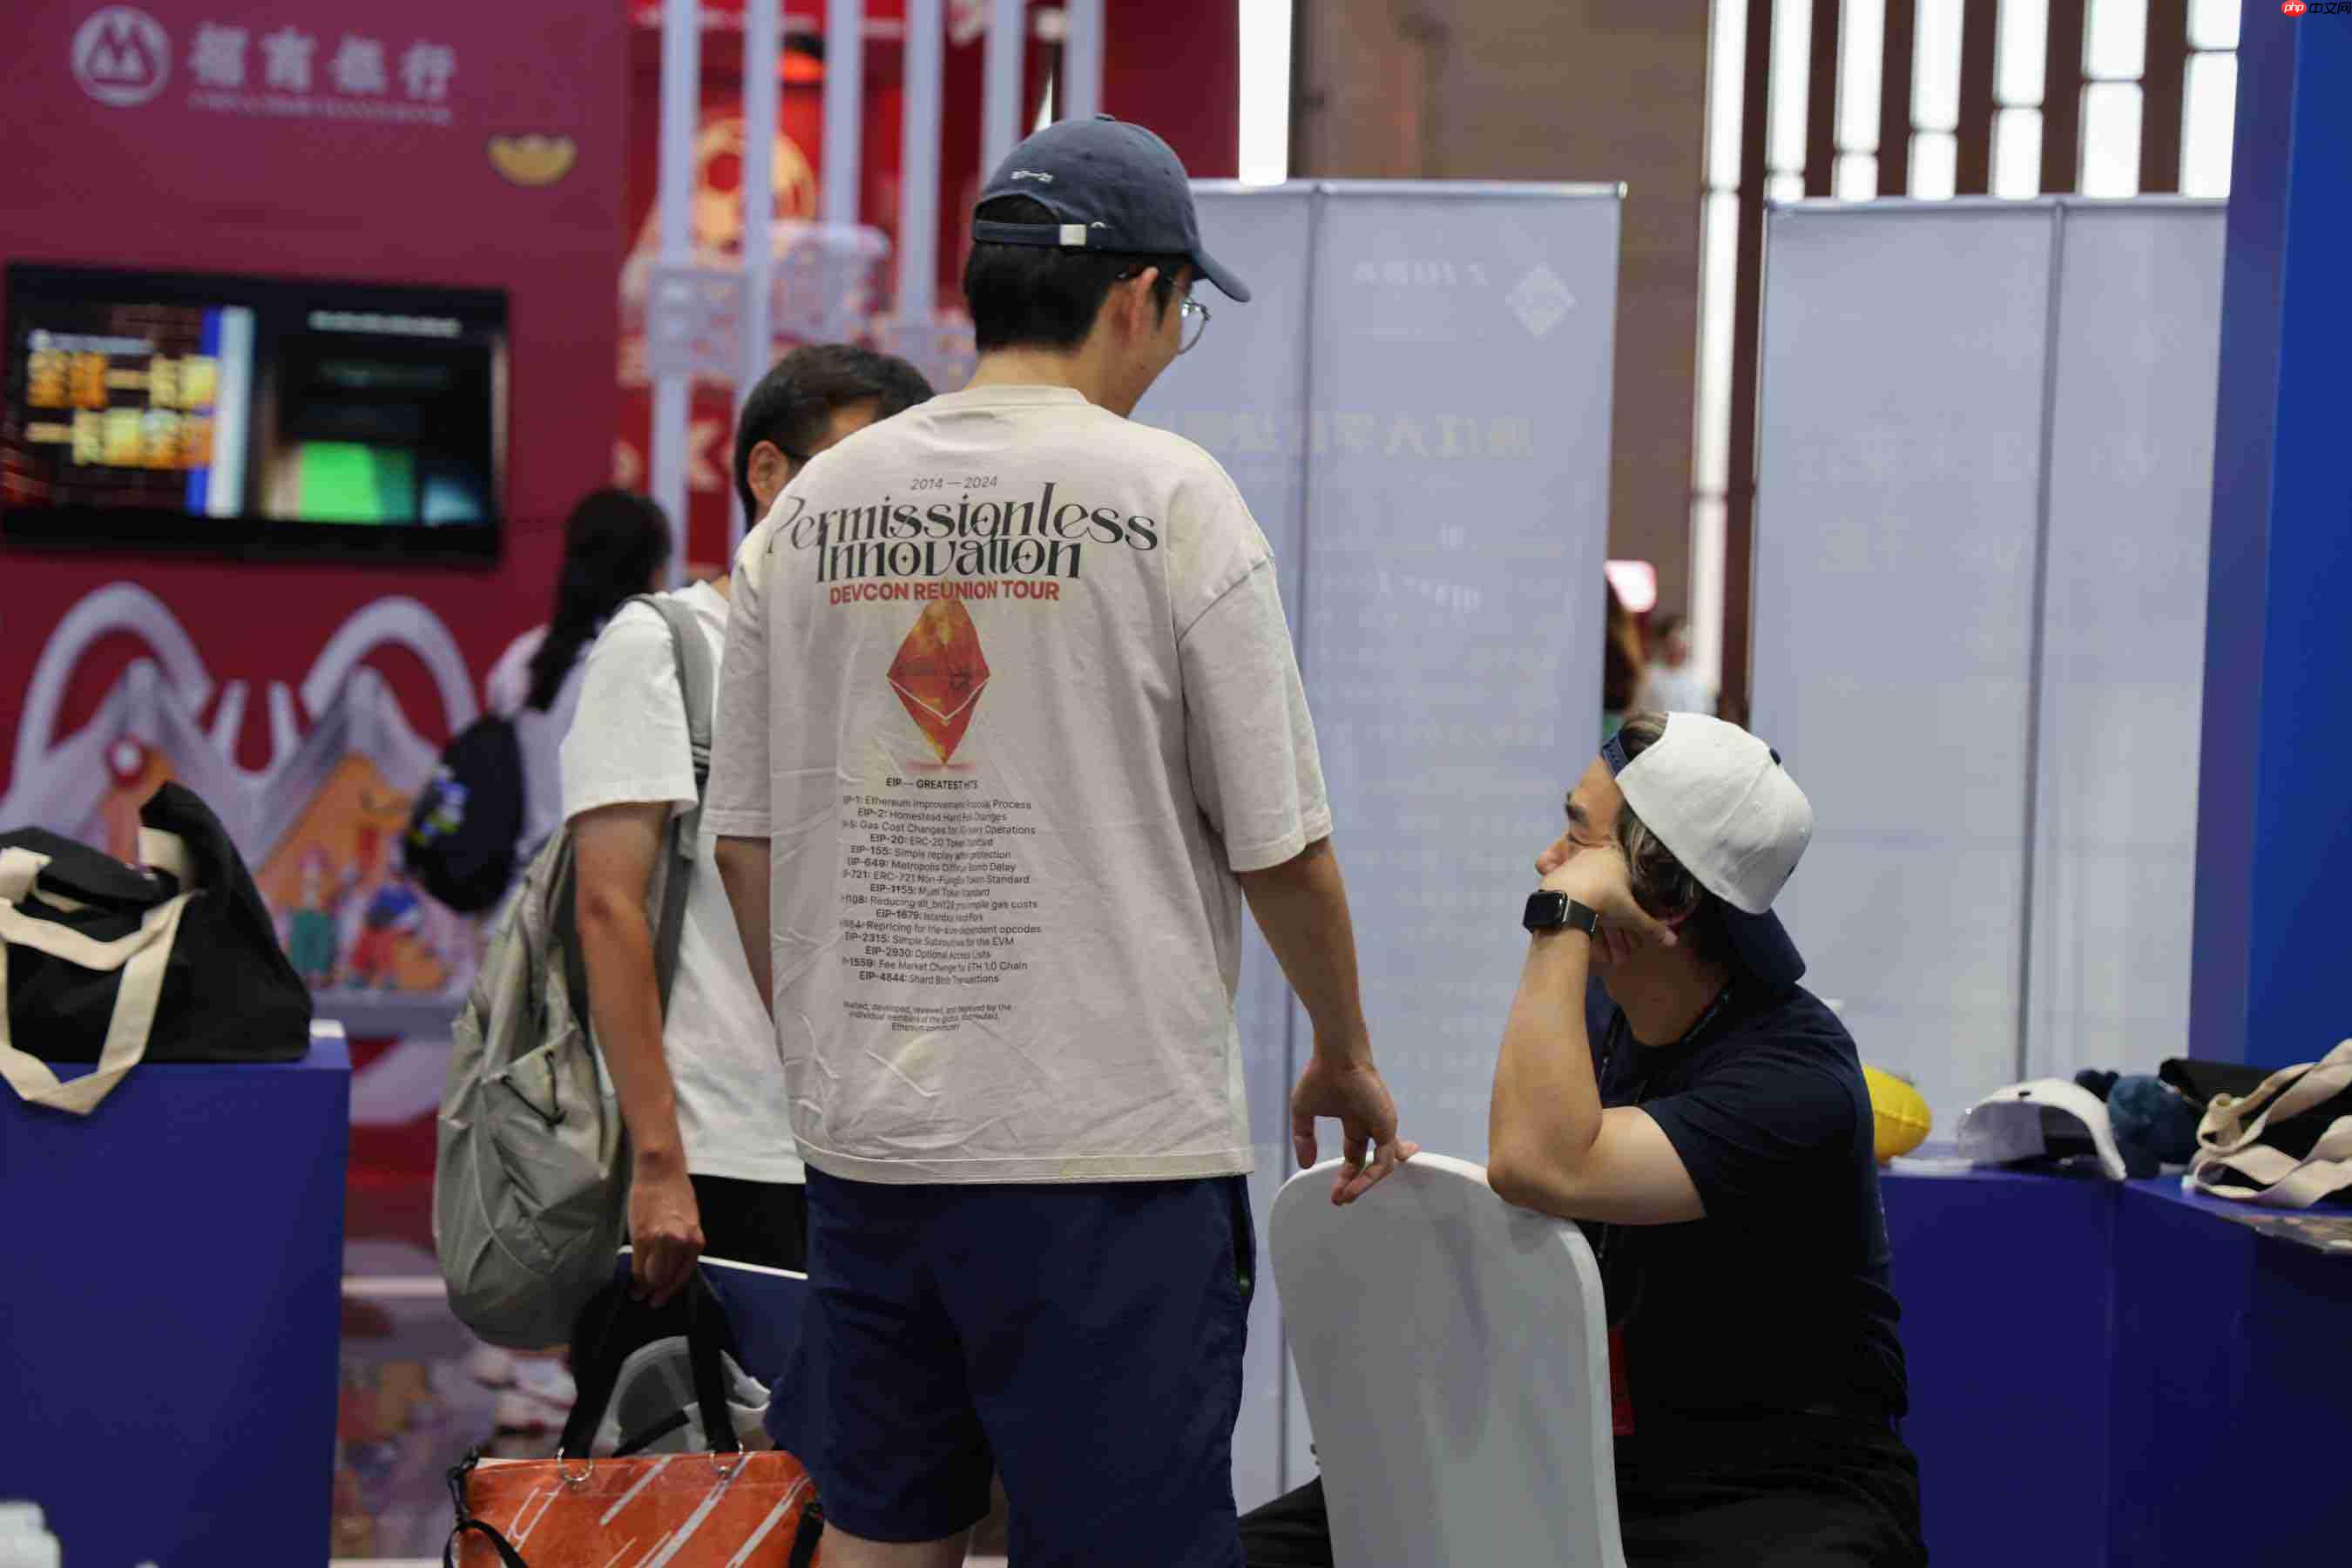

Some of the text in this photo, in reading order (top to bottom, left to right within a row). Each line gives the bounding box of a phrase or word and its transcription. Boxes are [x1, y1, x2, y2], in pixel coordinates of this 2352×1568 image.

[910, 478, 943, 490] 2014
[964, 476, 997, 489] 2024
[767, 481, 1159, 554] Permissionless
[814, 537, 1082, 584] Innovation
[829, 579, 1060, 605] DEVCON REUNION TOUR
[885, 777, 902, 787] EIP
[916, 779, 962, 790] GREATEST
[992, 799, 1031, 810] Process
[860, 821, 878, 830] Gas
[882, 821, 905, 833] Cost
[984, 825, 1037, 836] Operations
[870, 833, 908, 844] EIP-20:
[991, 936, 1015, 947] EVM
[999, 960, 1029, 970] Chain
